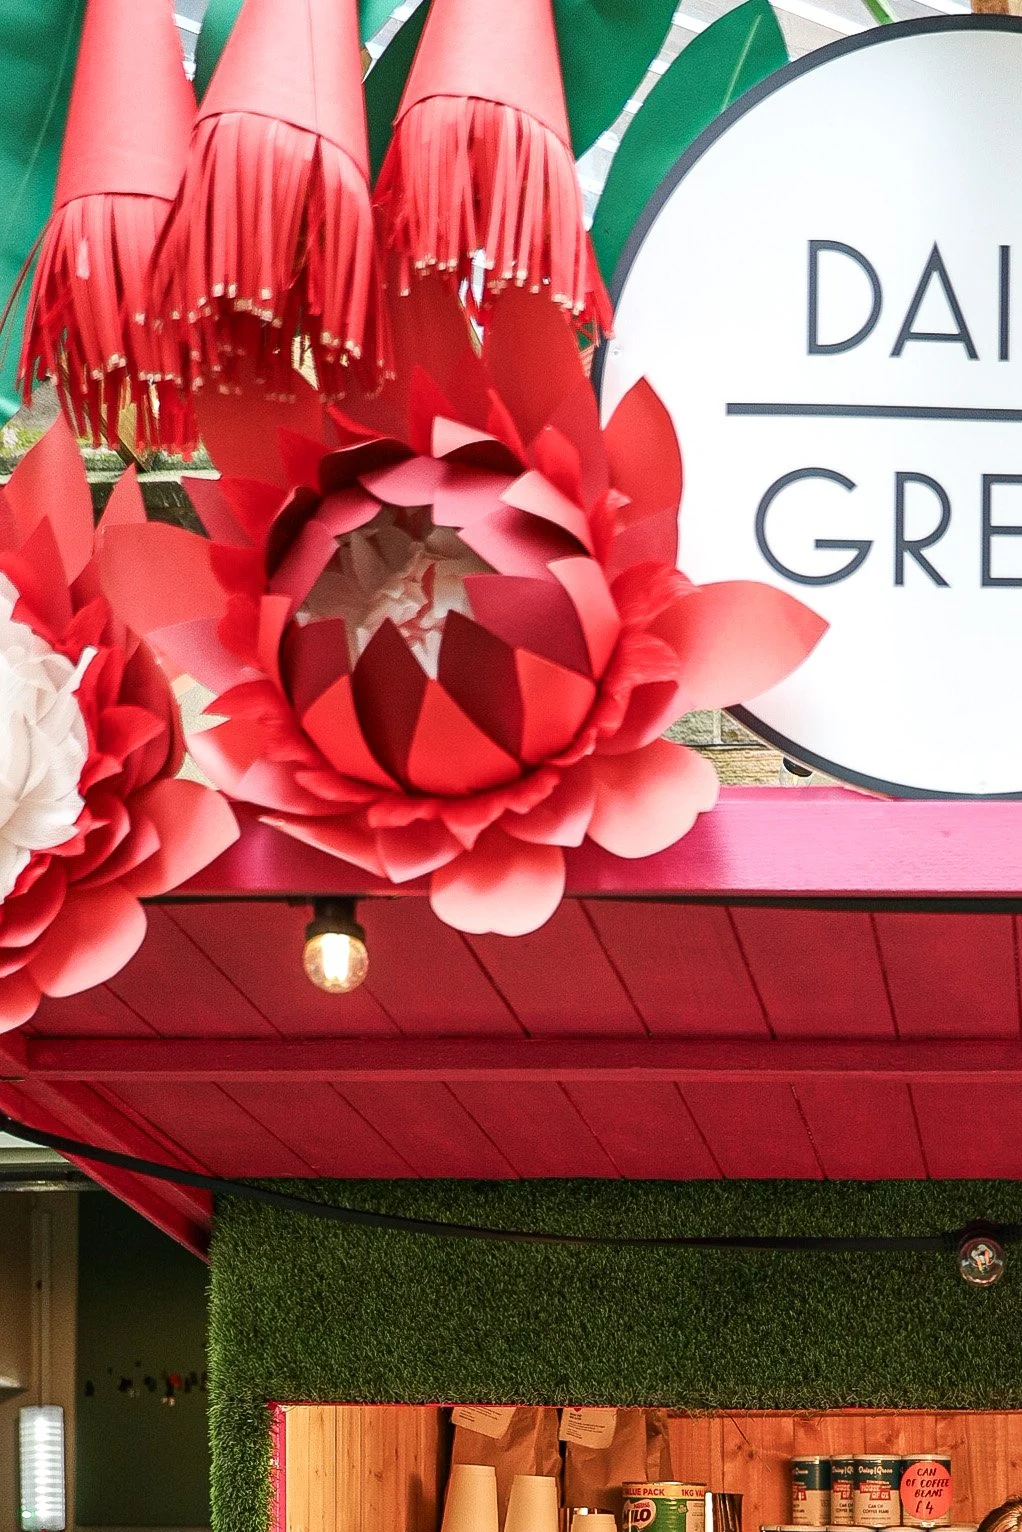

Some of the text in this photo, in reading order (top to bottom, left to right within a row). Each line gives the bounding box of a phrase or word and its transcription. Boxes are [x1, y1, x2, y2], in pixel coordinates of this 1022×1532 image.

[917, 1468, 936, 1476] CAN
[921, 1479, 949, 1487] COFFEE
[915, 1489, 943, 1497] BEANS
